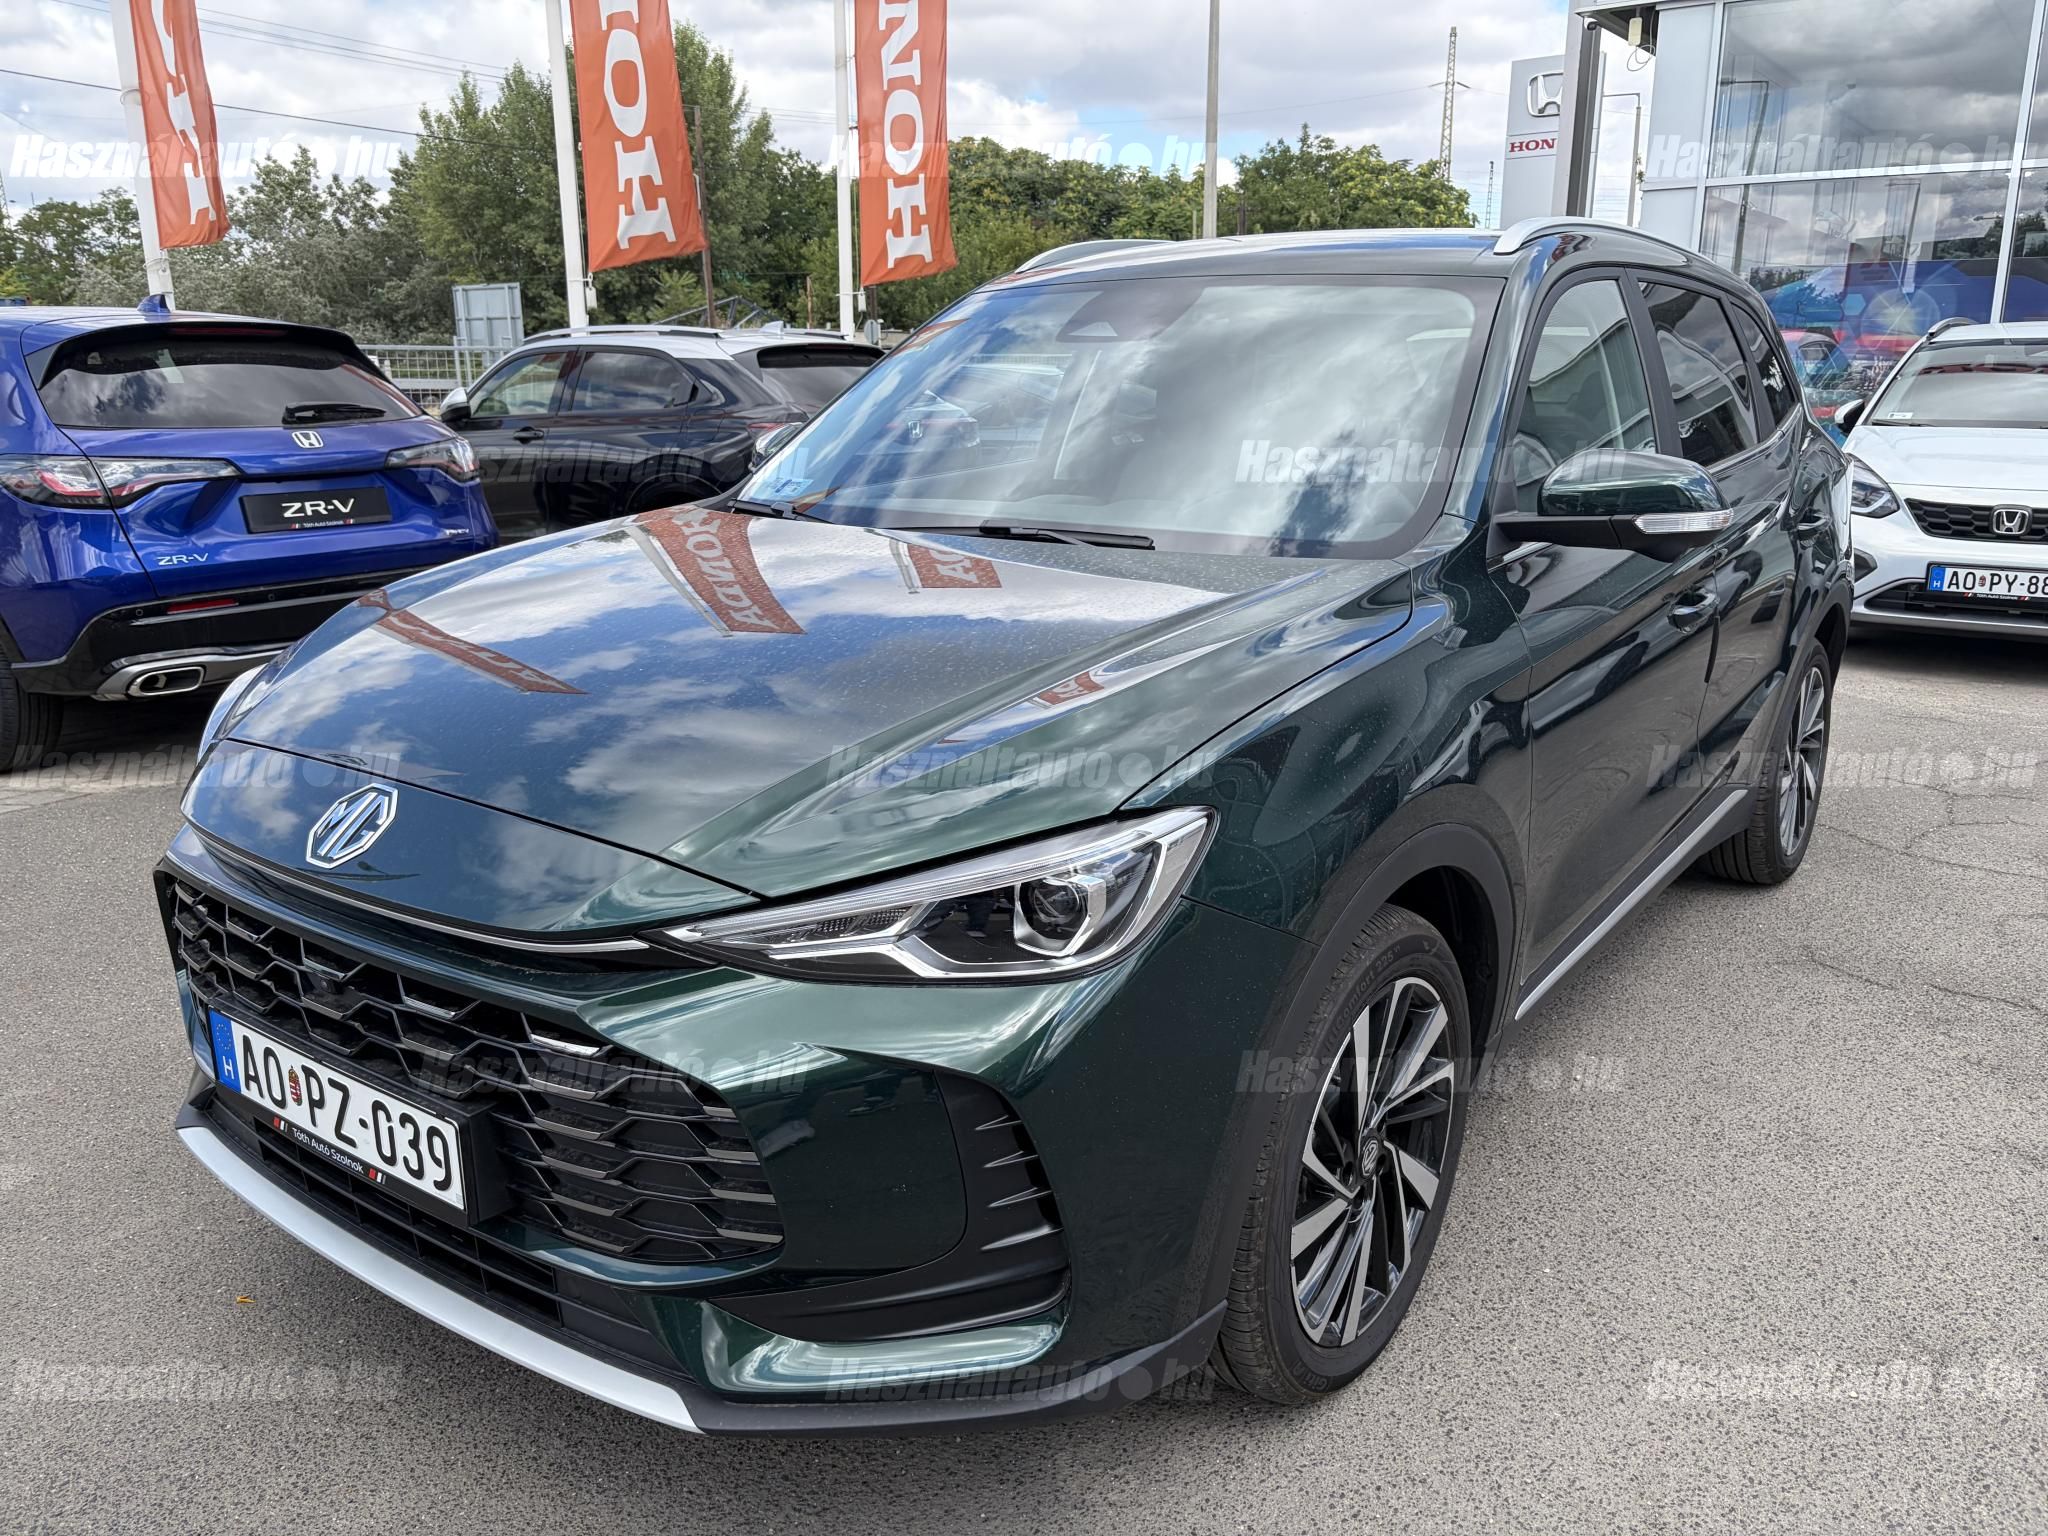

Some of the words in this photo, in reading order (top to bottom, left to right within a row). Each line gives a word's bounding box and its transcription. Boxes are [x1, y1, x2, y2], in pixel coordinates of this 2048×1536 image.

[281, 498, 355, 518] ZR-V
[157, 552, 209, 566] ZR-V
[1946, 570, 1977, 591] AO
[315, 791, 390, 861] MG
[222, 1055, 235, 1080] H
[242, 1034, 287, 1110] AO
[301, 1064, 452, 1192] PZ-039
[292, 1127, 311, 1145] Tóth
[311, 1138, 330, 1156] Autó
[330, 1149, 364, 1175] Szolnok
